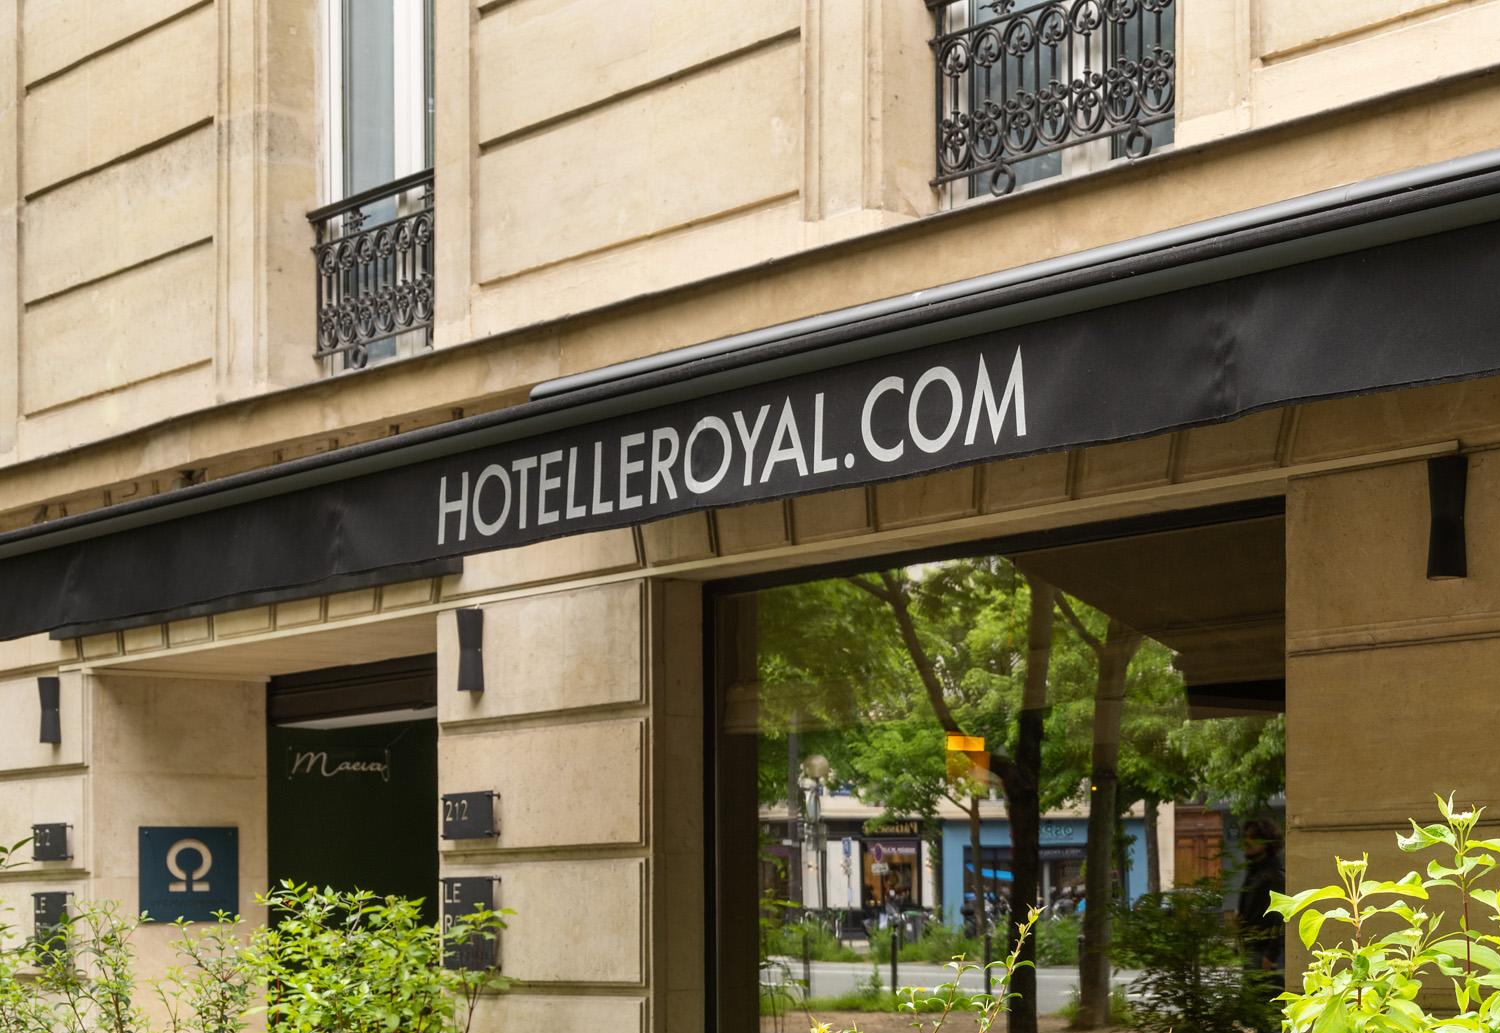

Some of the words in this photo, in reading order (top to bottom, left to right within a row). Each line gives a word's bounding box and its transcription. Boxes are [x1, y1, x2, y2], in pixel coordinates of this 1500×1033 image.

[437, 344, 1027, 546] HOTELLEROYAL.COM
[444, 799, 469, 822] 212
[444, 883, 462, 904] LE
